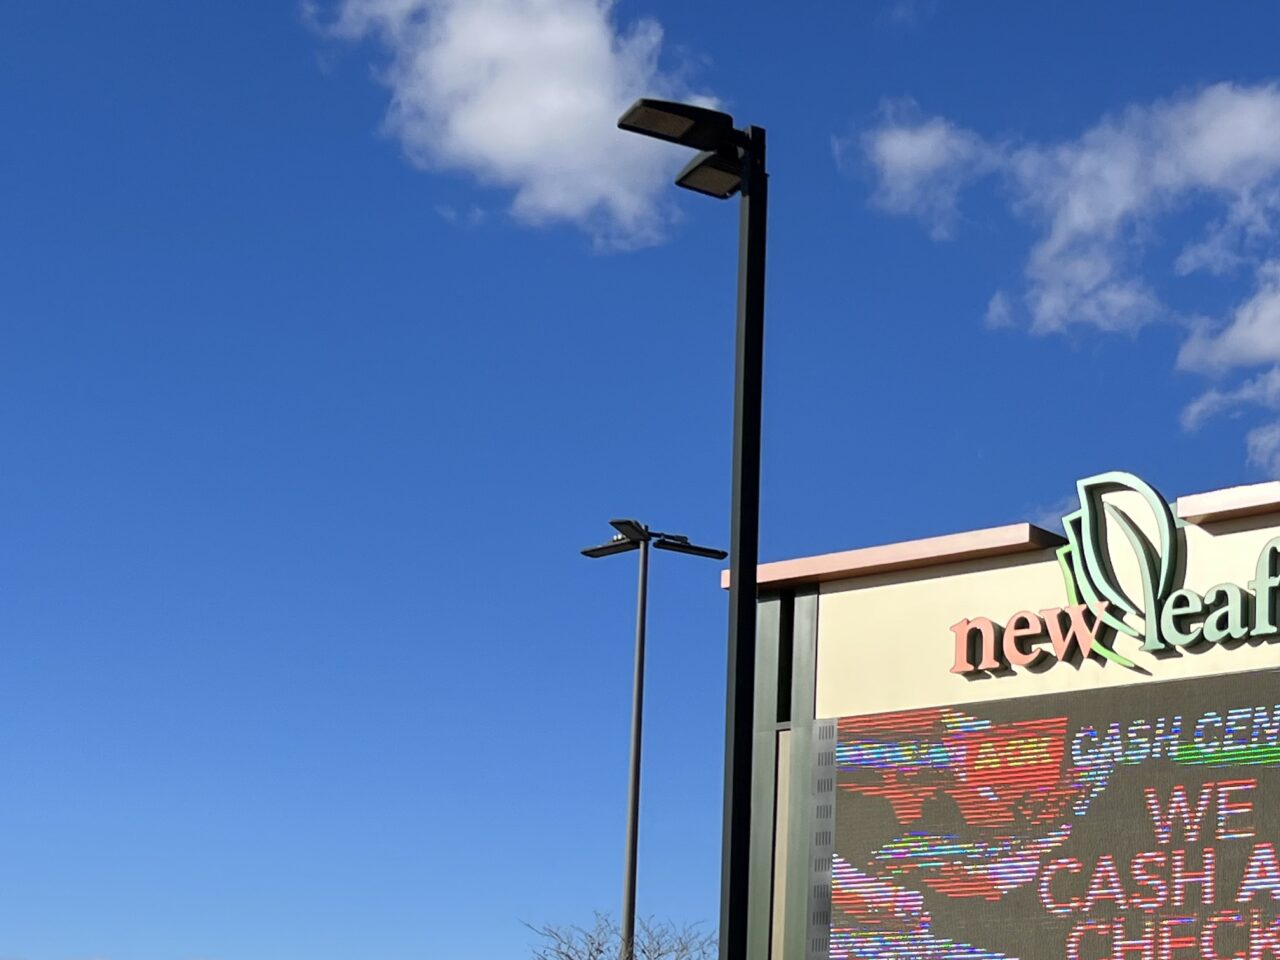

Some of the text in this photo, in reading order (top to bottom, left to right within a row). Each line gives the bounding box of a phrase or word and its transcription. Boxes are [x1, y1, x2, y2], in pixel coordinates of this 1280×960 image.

[950, 602, 1110, 674] new
[1071, 714, 1183, 767] CASH
[1144, 778, 1257, 845] WE
[1038, 847, 1215, 917] CASH
